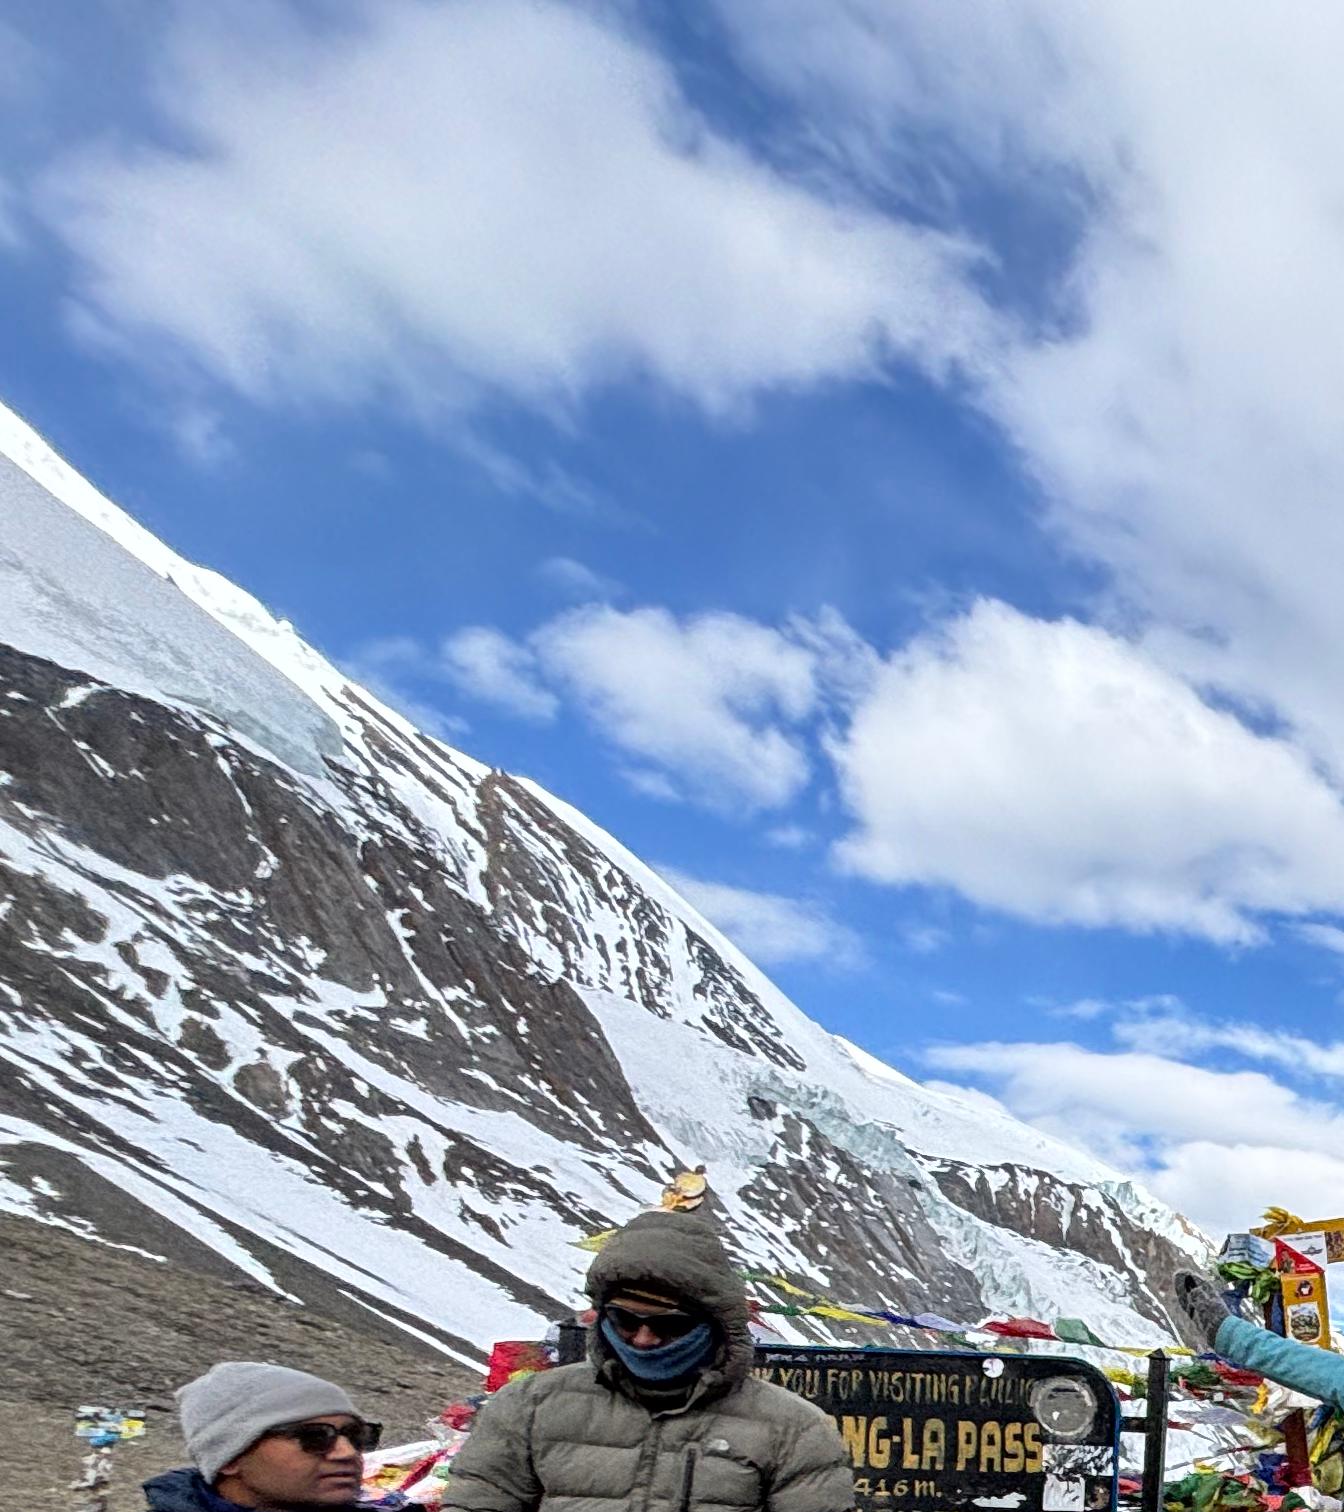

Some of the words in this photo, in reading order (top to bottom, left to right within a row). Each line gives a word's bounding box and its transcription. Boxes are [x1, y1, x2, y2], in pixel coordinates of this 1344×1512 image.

[779, 1367, 819, 1400] YOU
[868, 1370, 959, 1405] VISITING
[832, 1415, 946, 1471] NG-LA
[957, 1420, 1043, 1473] PASS
